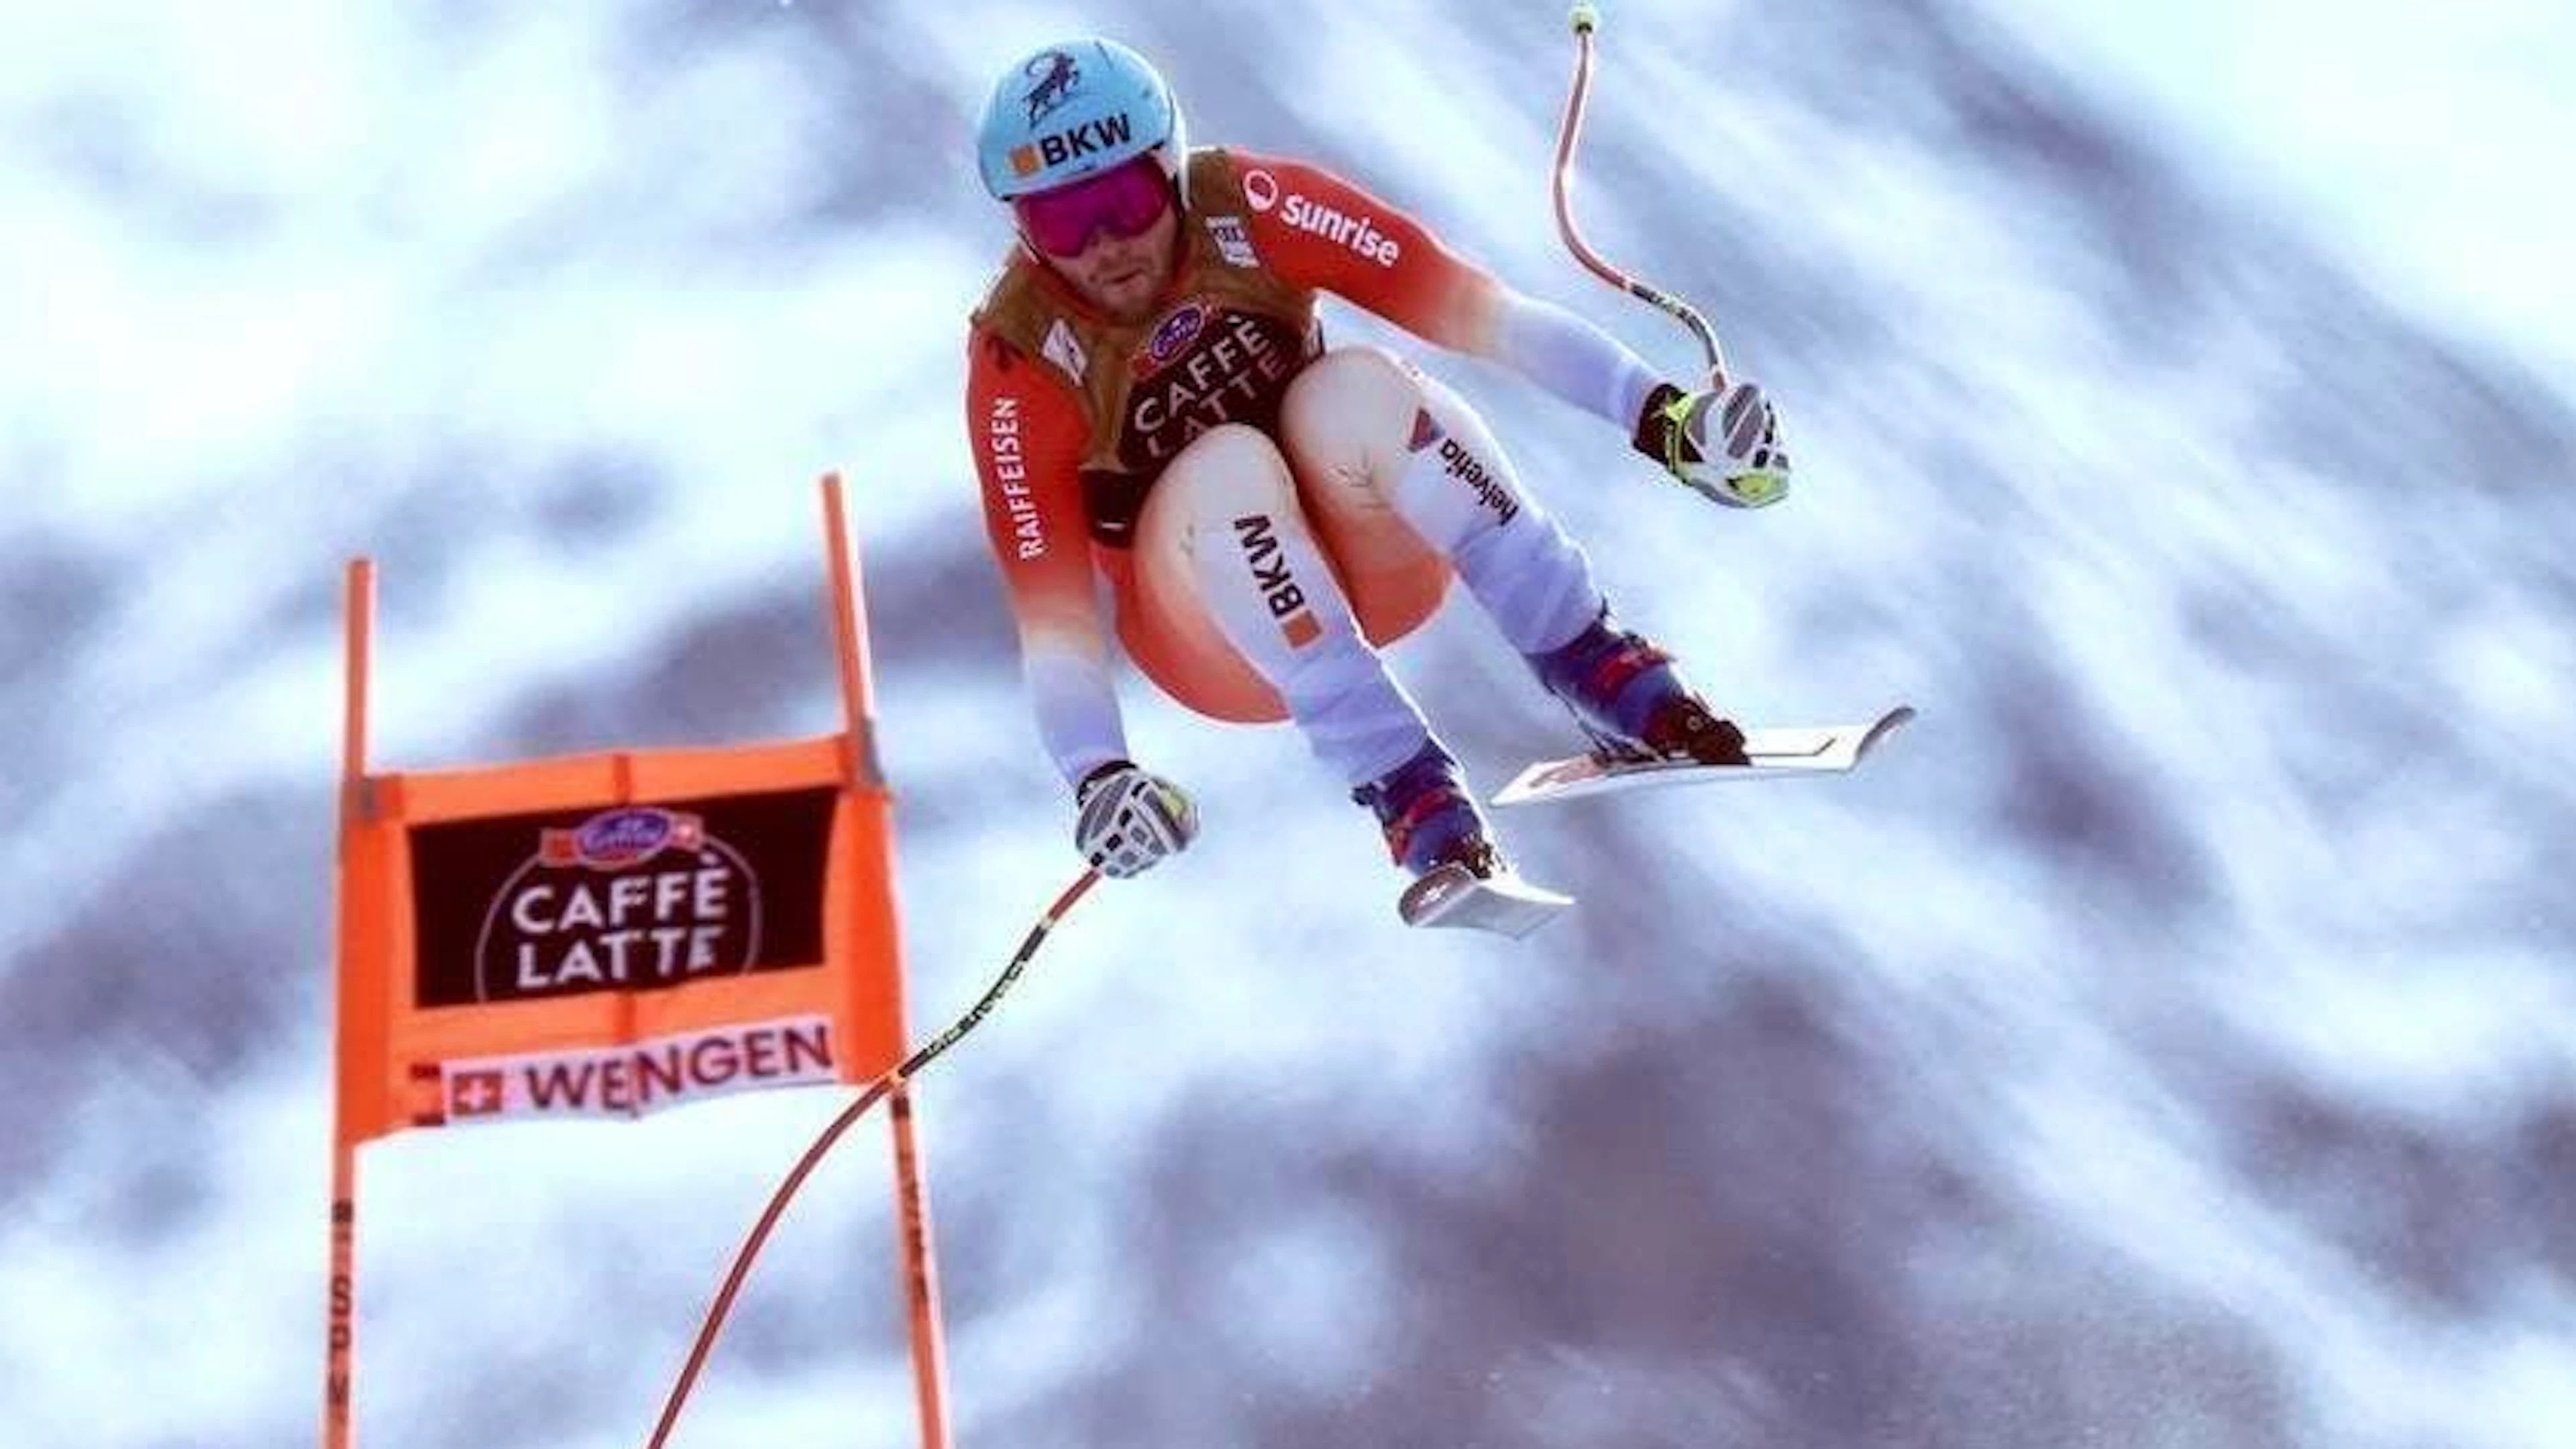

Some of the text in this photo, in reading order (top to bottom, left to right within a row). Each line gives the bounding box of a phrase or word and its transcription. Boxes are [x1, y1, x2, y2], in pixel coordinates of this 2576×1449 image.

[1040, 113, 1131, 167] BKW
[1282, 195, 1399, 267] sunrise
[1135, 314, 1269, 431] CAFFÈ
[991, 398, 1044, 560] RAIFFEISEN
[1440, 439, 1518, 527] helvetia
[1234, 515, 1304, 619] BKW
[513, 854, 731, 933] CAFFÈ
[518, 926, 724, 987] LATTE
[525, 1024, 833, 1111] WENGEN
